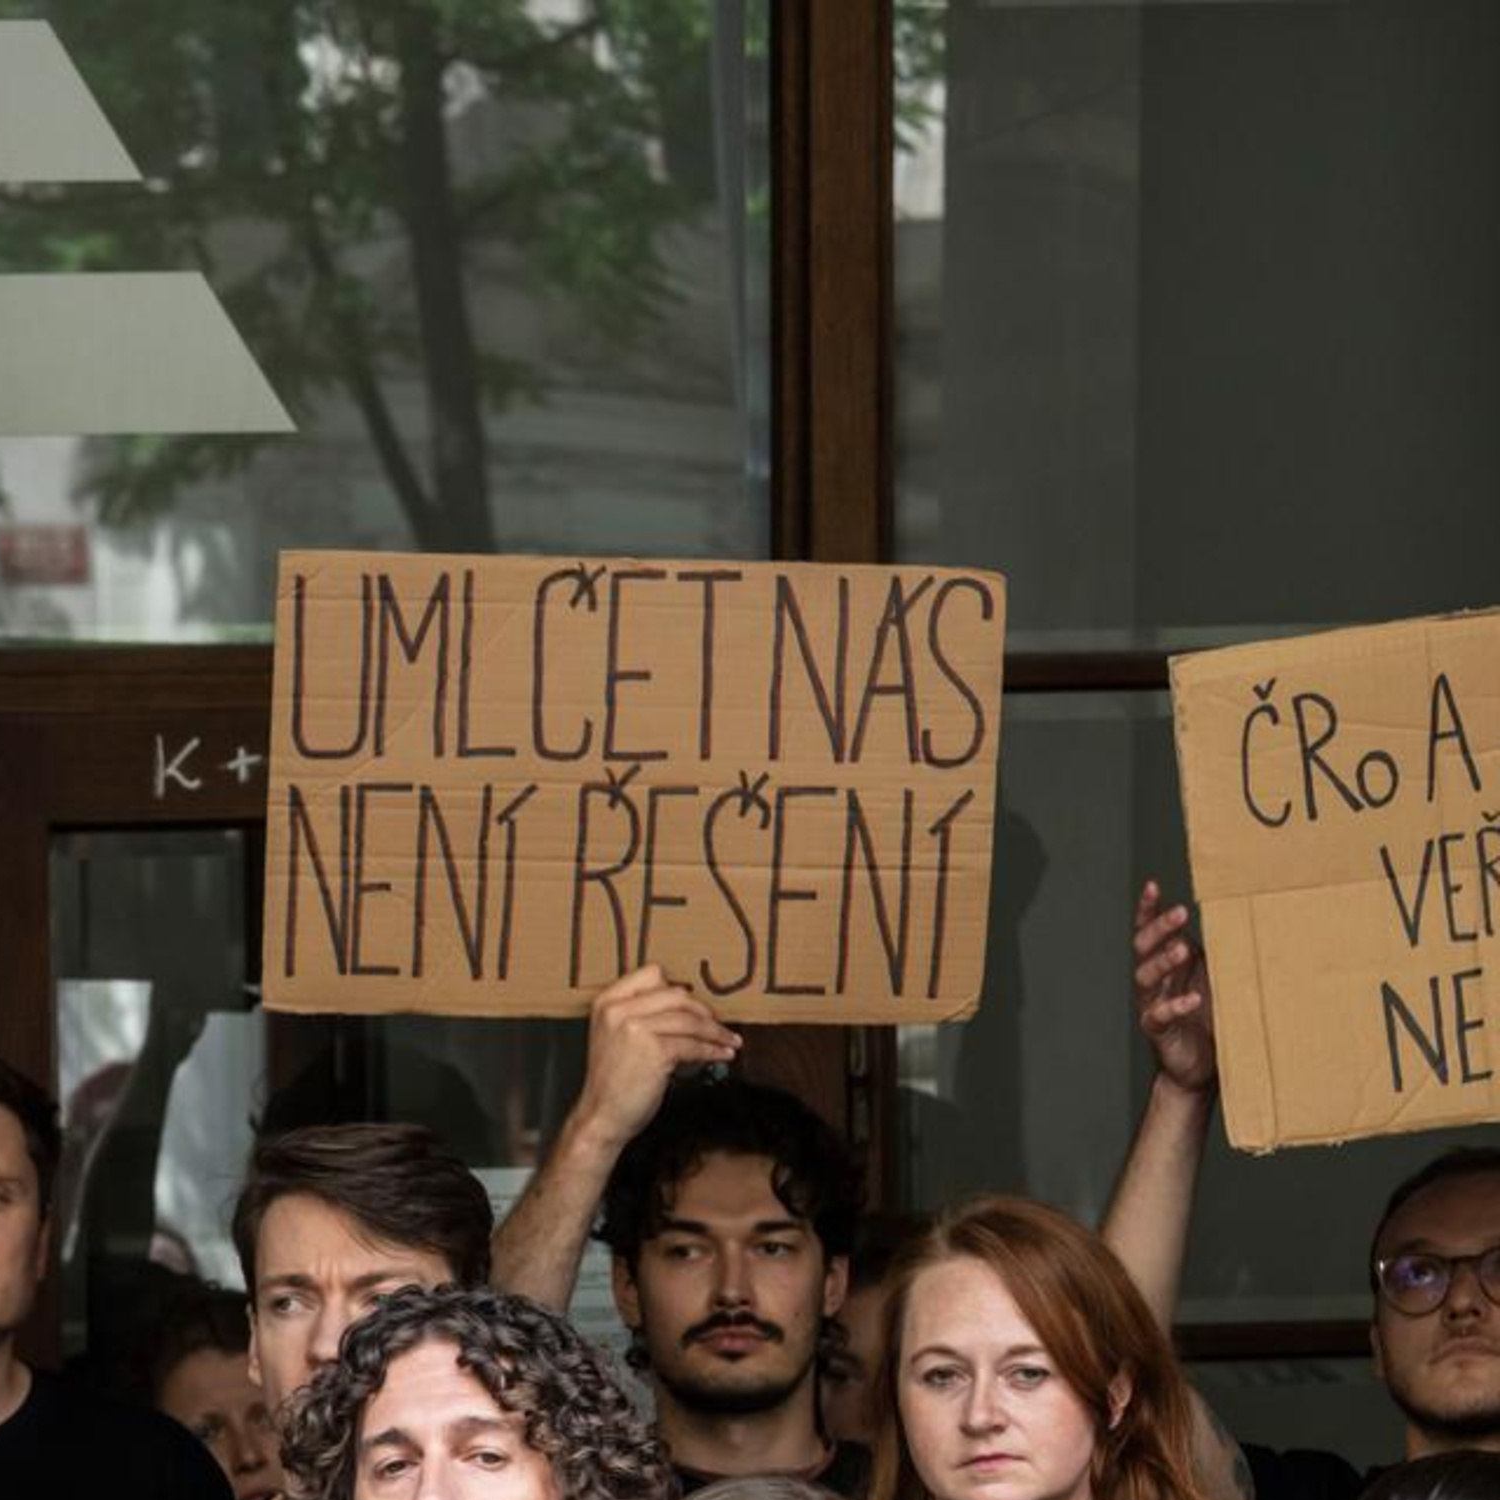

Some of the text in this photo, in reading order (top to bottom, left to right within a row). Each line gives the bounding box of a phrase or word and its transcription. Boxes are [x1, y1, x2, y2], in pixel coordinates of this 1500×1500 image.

[290, 563, 994, 769] UMLČET NÁS
[1241, 673, 1482, 828] ČRo A
[284, 764, 975, 999] NENÍ ŘEŠENÍ
[1381, 967, 1493, 1092] NE
